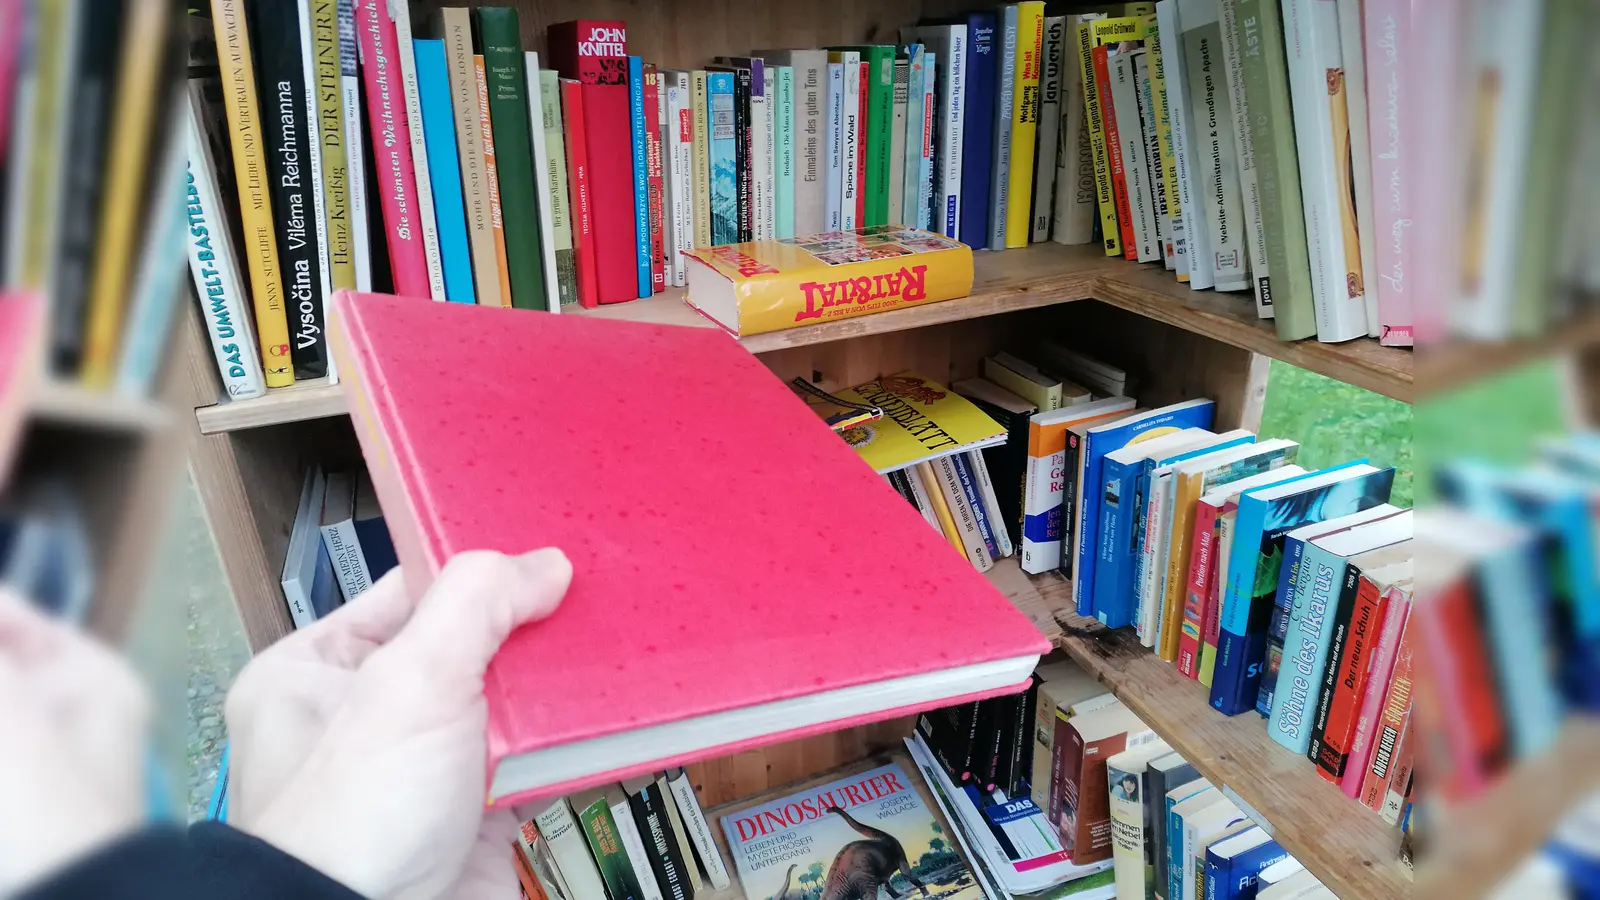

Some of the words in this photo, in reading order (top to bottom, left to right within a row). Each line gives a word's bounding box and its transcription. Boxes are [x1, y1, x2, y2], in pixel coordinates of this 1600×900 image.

[588, 28, 627, 43] JOHN
[1095, 23, 1113, 36] Leopold
[453, 25, 466, 75] LONDON
[578, 42, 627, 57] KNITTEL
[1023, 50, 1032, 60] ist
[1027, 13, 1044, 80] Kommunismus?
[1199, 38, 1211, 72] Apache
[803, 68, 816, 89] Tons
[1022, 60, 1030, 80] Was
[1080, 28, 1096, 101] Weltkommunismus
[459, 79, 469, 103] VON
[475, 65, 490, 121] Wintergäste
[645, 73, 656, 86] 18
[233, 68, 251, 131] VERTRAUEN
[407, 73, 422, 145] Schokolade
[805, 91, 819, 116] guten
[1019, 85, 1032, 123] Wolfgang
[1027, 85, 1040, 123] Leonhard
[1204, 74, 1216, 128] Grundlagen
[322, 108, 339, 146] DER
[463, 107, 474, 145] RABEN
[782, 114, 790, 133] Maus
[804, 118, 815, 134] des
[847, 114, 855, 143] Wald
[1089, 101, 1101, 134] Legende
[243, 132, 255, 157] UND
[278, 81, 300, 187] Reichmanna
[832, 127, 840, 153] Sawyers
[468, 149, 477, 168] DIE
[804, 136, 816, 182] Einmaleins
[846, 143, 853, 159] im
[1092, 138, 1106, 174] Grünwald
[1109, 131, 1122, 174] blueprint
[1149, 135, 1163, 179] RODRIAN
[247, 160, 260, 189] LIEBE
[390, 151, 406, 213] schönsten
[470, 171, 480, 195] UND
[845, 160, 854, 199] Spione
[1097, 174, 1110, 203] Leopold
[1168, 165, 1180, 205] WITTLER
[1390, 166, 1400, 211] zum
[552, 194, 562, 214] grüne
[579, 184, 587, 213] VALENTIN
[1156, 182, 1168, 215] IRENE
[1212, 140, 1227, 244] Website-Administration
[287, 193, 306, 250] Viléma
[473, 199, 484, 230] MOHR
[491, 202, 502, 229] Helga
[740, 199, 748, 231] STEPHEN
[947, 195, 955, 227] KRÜGER
[396, 216, 411, 240] Die
[1391, 217, 1412, 254] weg
[333, 224, 348, 264] Heinz
[427, 227, 442, 291] Schokolade
[266, 281, 280, 310] JENNY
[292, 260, 320, 348] Vysočina
[798, 264, 928, 321] RAT&TAT
[1260, 278, 1272, 303] jovis
[831, 308, 844, 316] BIS
[849, 305, 866, 313] VON
[865, 302, 883, 311] TIPS
[222, 343, 245, 378] DAS
[940, 456, 954, 481] MESSER
[949, 480, 959, 494] DEM
[954, 494, 964, 505] MIT
[958, 504, 970, 522] IRREN
[964, 520, 974, 532] DIE
[328, 527, 343, 553] HERZ
[1200, 531, 1211, 547] Maß
[336, 553, 352, 577] MEIN
[1200, 547, 1208, 564] nach
[1289, 560, 1299, 573] Erbe
[1195, 564, 1205, 587] Portion
[1288, 574, 1296, 585] Das
[1283, 587, 1294, 612] SHELDON
[1298, 563, 1334, 639] Ikarus
[1279, 614, 1289, 632] SIDNEY
[1355, 605, 1370, 639] Schuh
[1291, 637, 1318, 676] des
[1328, 661, 1337, 676] Mann
[1335, 624, 1345, 643] Straße
[1350, 639, 1363, 668] neue
[1343, 669, 1356, 689] Der
[1277, 676, 1309, 739] Söhne
[1378, 726, 1397, 754] REISEN
[1373, 751, 1390, 777] ANDERS
[734, 772, 905, 842] DINOSAURIER
[876, 802, 918, 820] WALLACE
[879, 794, 913, 811] JOSEPH
[1005, 800, 1033, 814] DAS
[646, 812, 668, 855] WOLFSSPINNE
[744, 840, 775, 855] LEBEN
[777, 832, 797, 848] UND
[748, 835, 813, 863] MYSTERIÖSER
[750, 846, 811, 872] UNTERGANG
